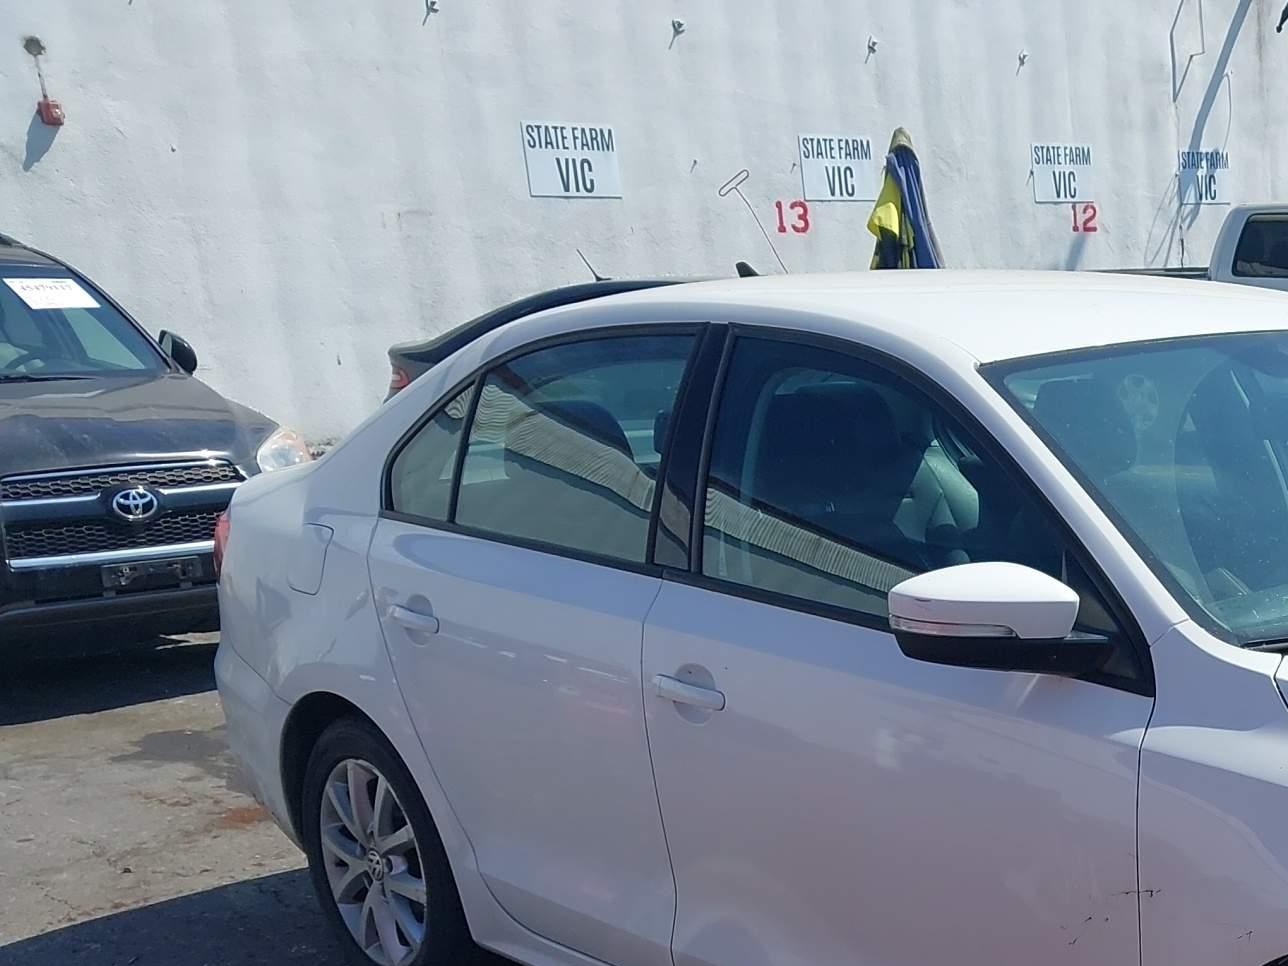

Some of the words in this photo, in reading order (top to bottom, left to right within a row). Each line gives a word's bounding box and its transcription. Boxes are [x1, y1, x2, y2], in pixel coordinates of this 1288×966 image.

[526, 125, 569, 150] STATE
[571, 127, 615, 152] FARM
[802, 138, 836, 159] STATE
[838, 139, 871, 160] FARM
[1034, 146, 1062, 165] STATE
[1064, 147, 1091, 166] FARM
[1181, 151, 1204, 169] STATE
[1205, 151, 1229, 169] FARM
[555, 157, 595, 193] VIC
[825, 166, 855, 197] VIC
[1052, 170, 1077, 198] VIC
[1196, 174, 1217, 200] VIC
[775, 200, 810, 233] 13
[1071, 203, 1098, 232] 12
